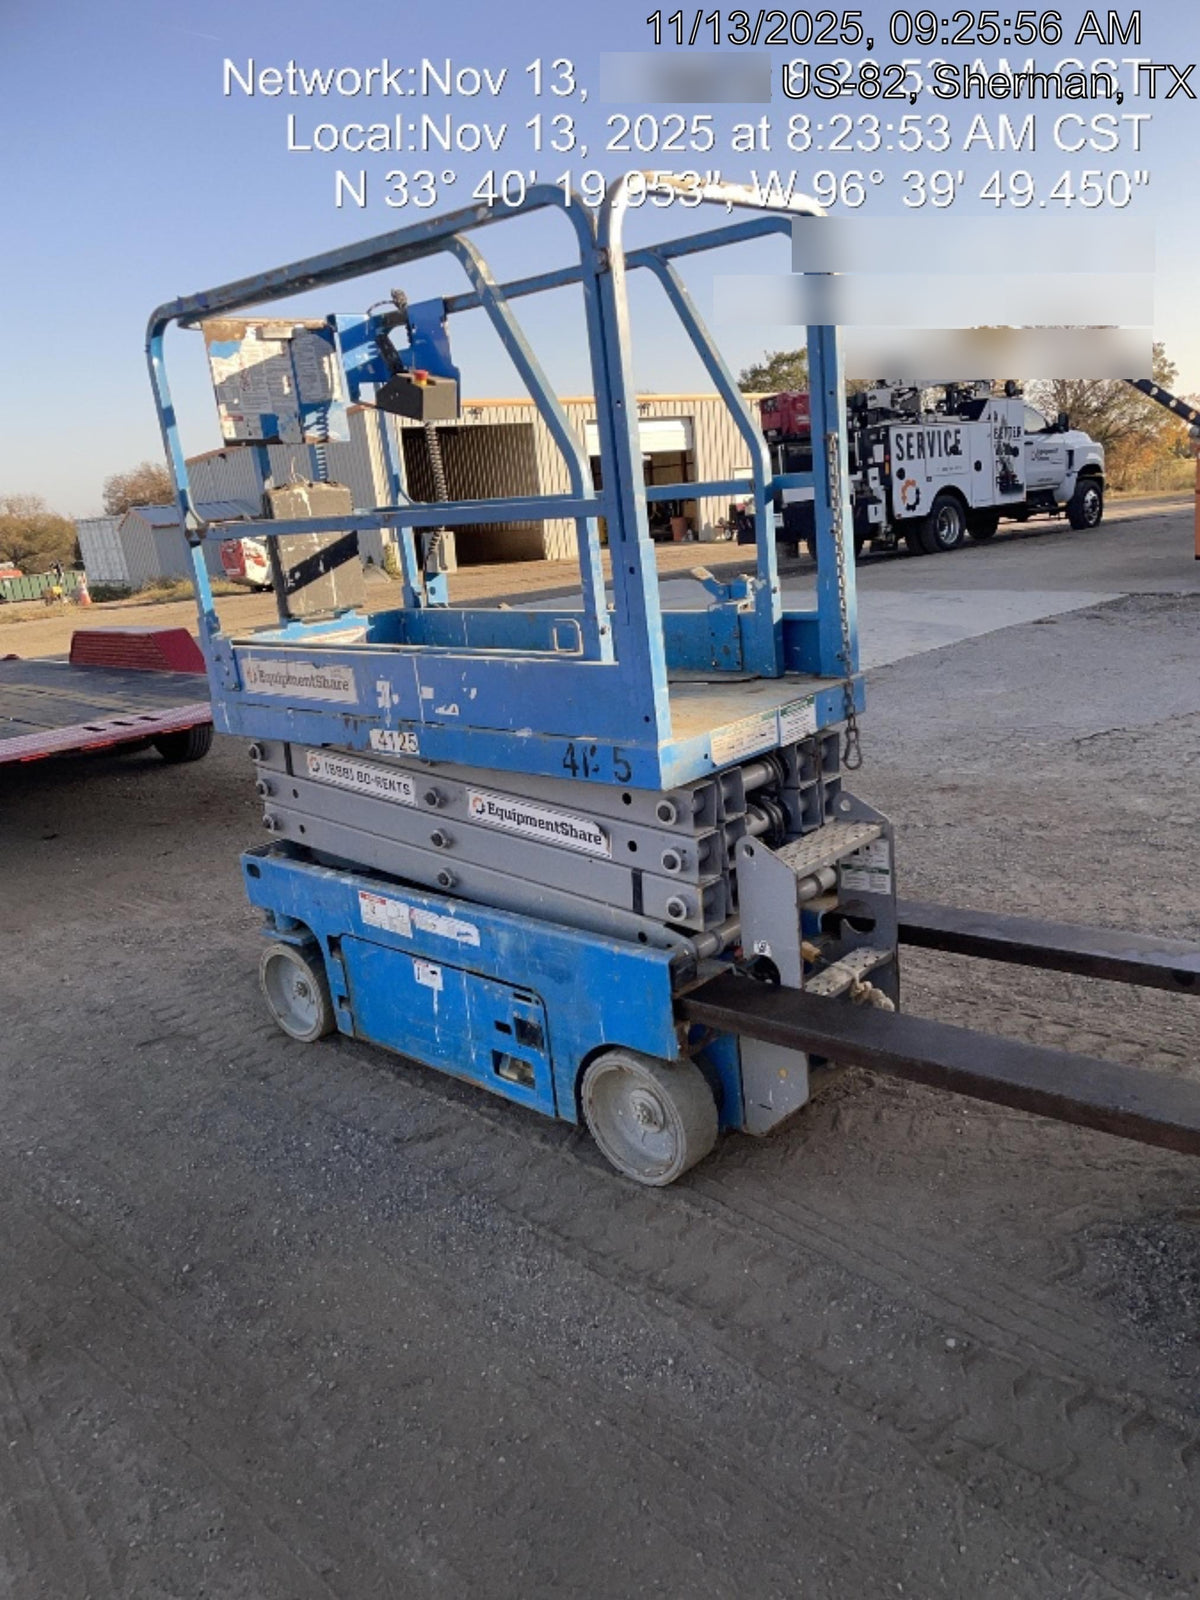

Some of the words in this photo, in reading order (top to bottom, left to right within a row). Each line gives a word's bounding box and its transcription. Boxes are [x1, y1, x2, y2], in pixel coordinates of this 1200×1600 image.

[895, 429, 963, 461] SERVICE
[258, 668, 350, 693] EquipmentShare
[377, 731, 418, 754] 4125
[486, 800, 603, 846] EquipmentShare
